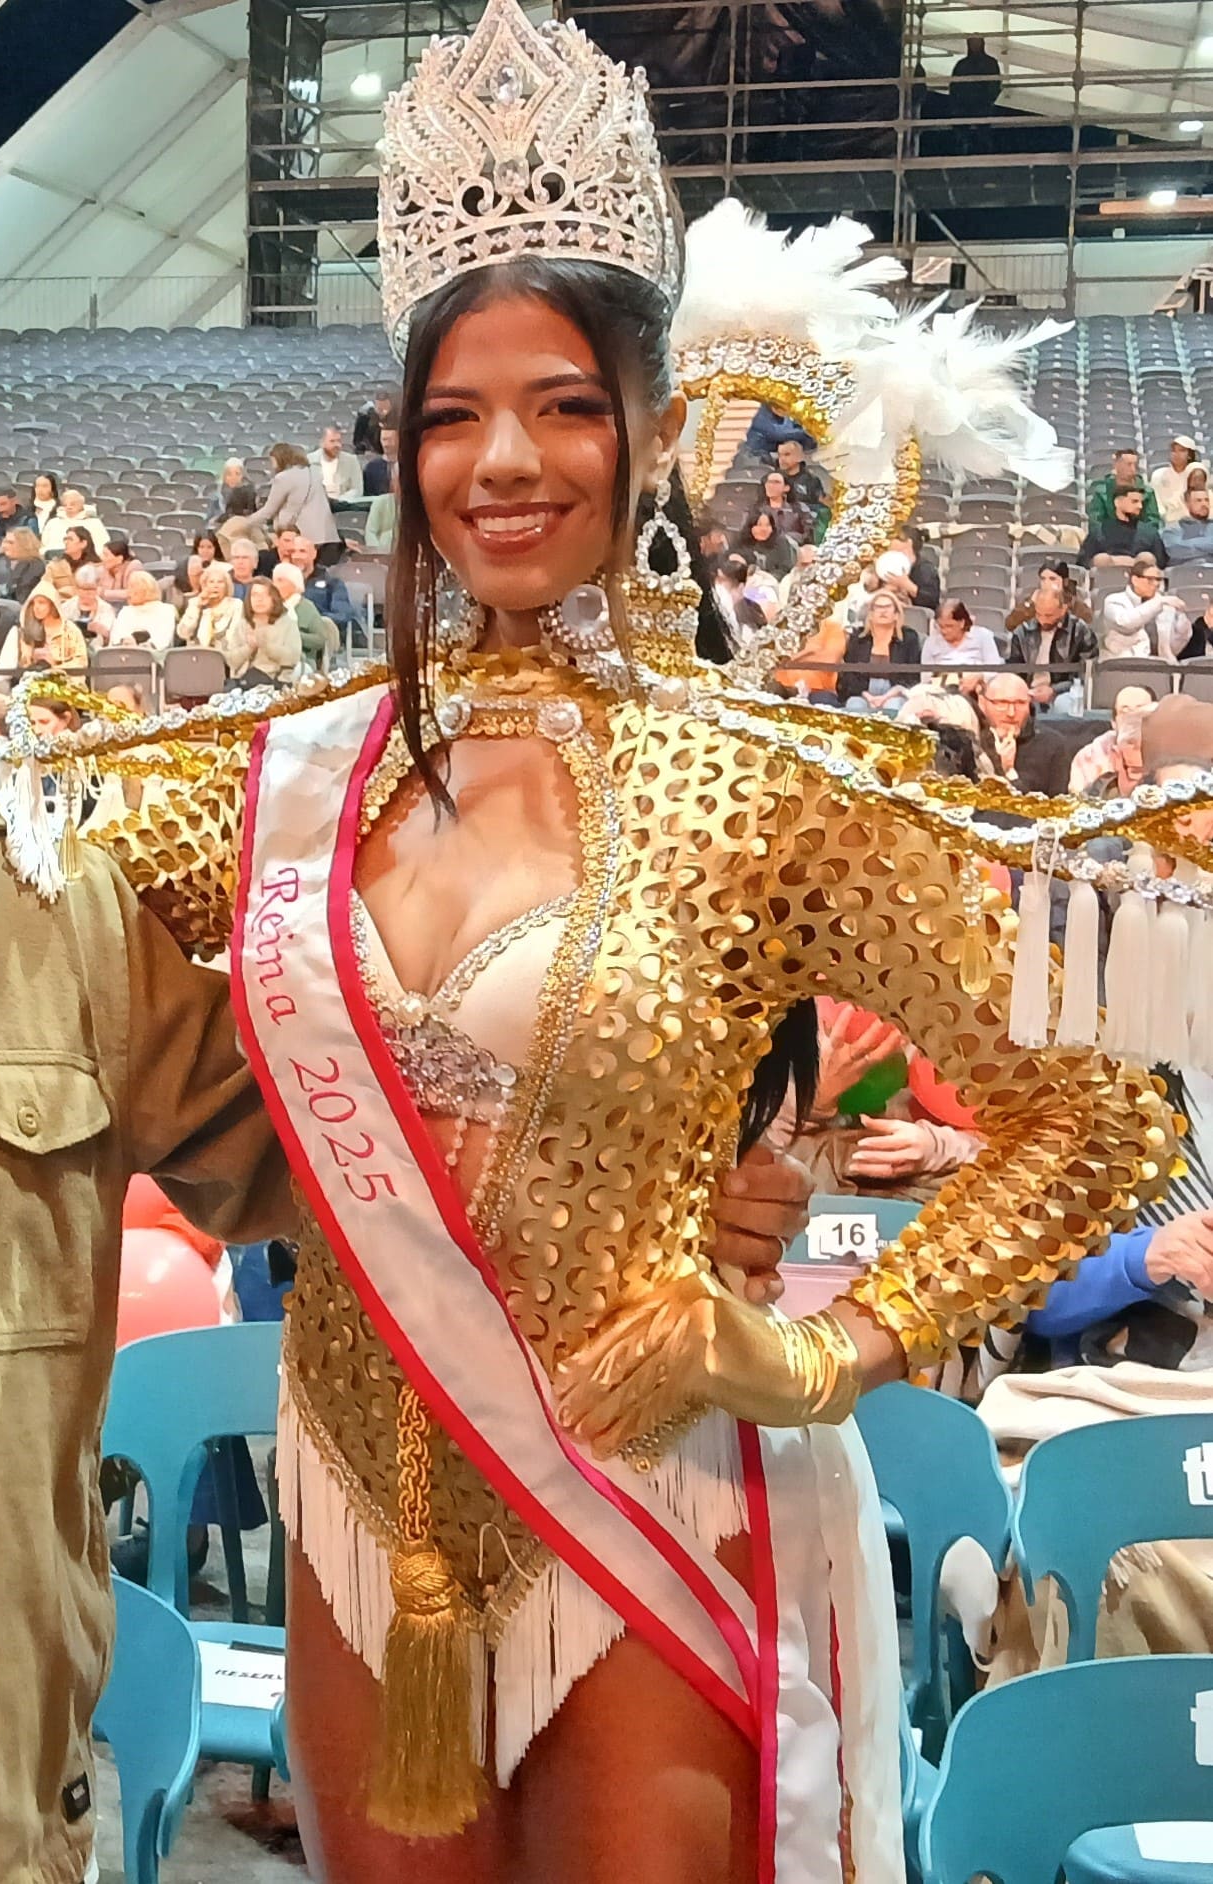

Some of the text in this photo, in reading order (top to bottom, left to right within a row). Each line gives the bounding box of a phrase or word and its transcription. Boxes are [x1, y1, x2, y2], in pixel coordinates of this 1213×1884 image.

[252, 867, 397, 1202] Reina 2025
[832, 1222, 866, 1247] 16
